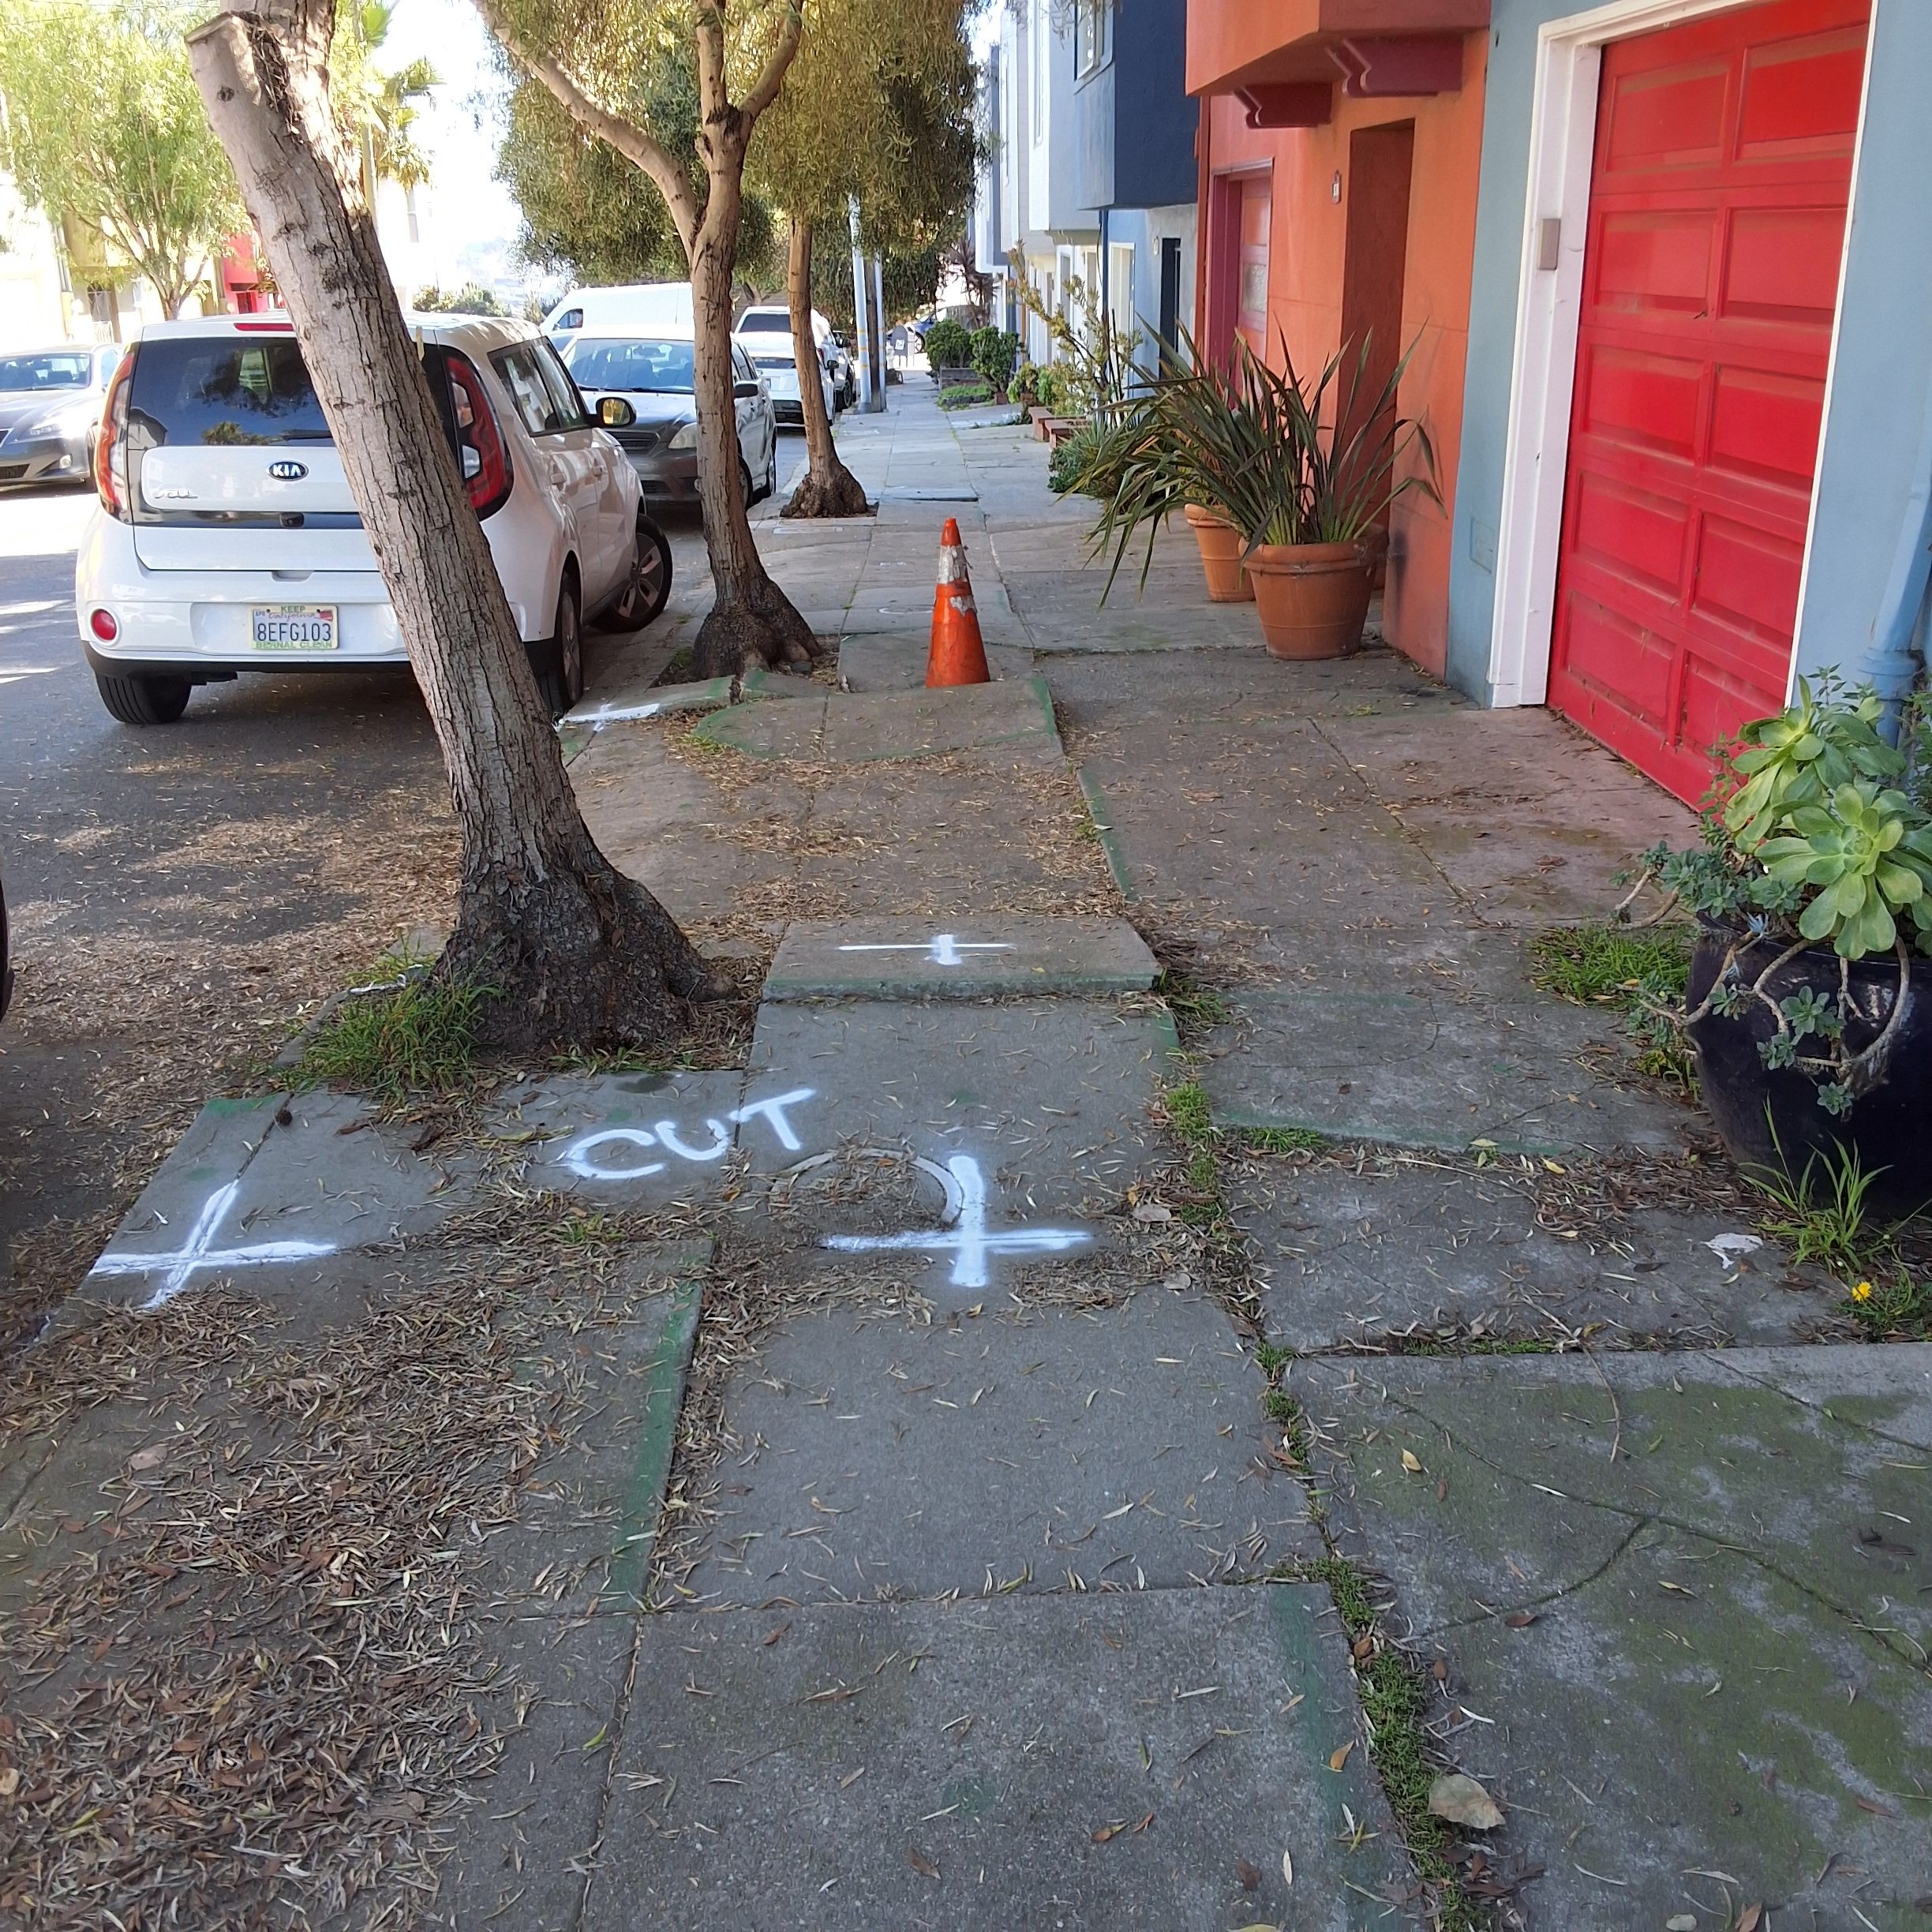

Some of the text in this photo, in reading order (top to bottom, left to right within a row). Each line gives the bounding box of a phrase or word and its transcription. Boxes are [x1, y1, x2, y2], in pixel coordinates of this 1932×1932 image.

[272, 464, 302, 477] KIA
[257, 623, 331, 642] 8EFG103
[564, 1088, 818, 1180] CUT
